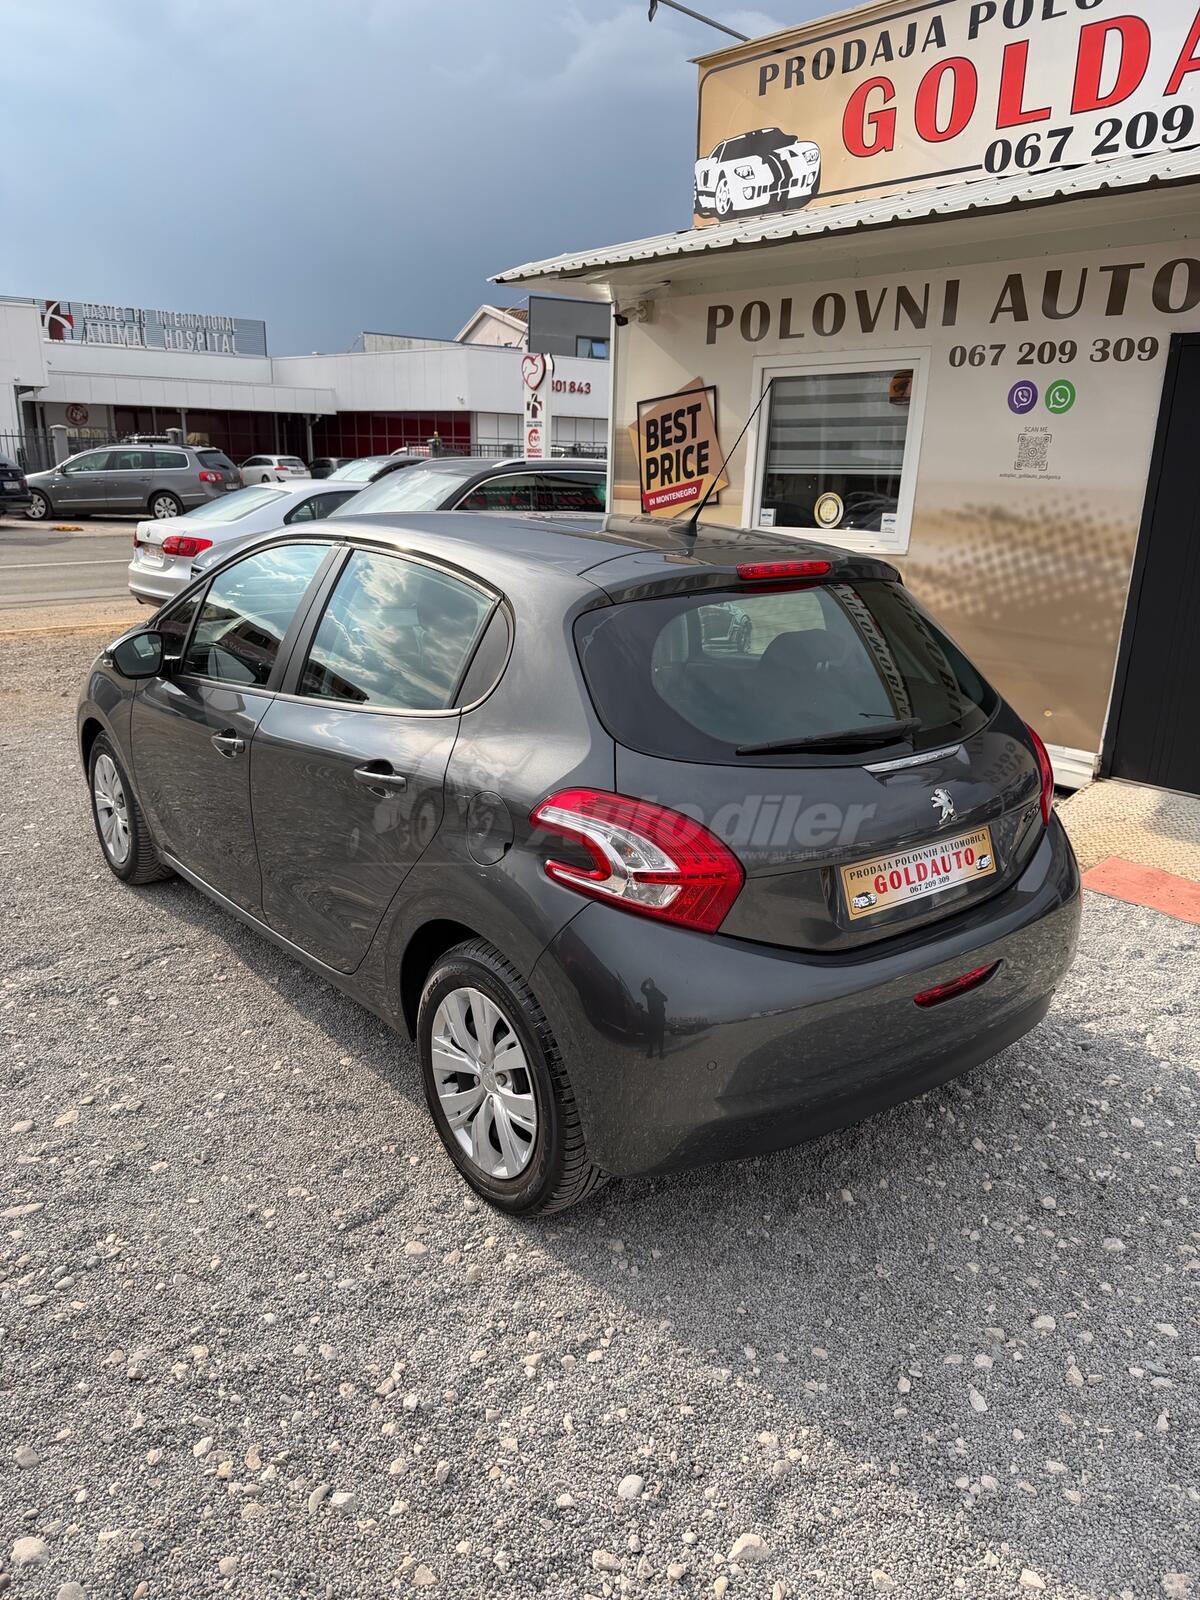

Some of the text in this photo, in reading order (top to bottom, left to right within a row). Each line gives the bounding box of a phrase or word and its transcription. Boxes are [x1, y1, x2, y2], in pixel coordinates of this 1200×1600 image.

[758, 0, 1104, 97] PRODAJA POL
[984, 104, 1194, 174] 067 209
[156, 310, 238, 332] INTERNATIONAL
[705, 257, 1200, 345] POLOVNI AUTO
[86, 322, 239, 354] ANIMAL HOSPITAL
[948, 336, 1160, 368] 067 209 309
[569, 381, 592, 394] 843
[645, 402, 702, 453] BEST
[645, 440, 709, 491] PRICE
[649, 487, 698, 506] IN MONTENEGRO
[849, 833, 987, 881] PRODAJA POLOVNIH AUTOMOBILA
[874, 847, 976, 895] GOLDAUTO
[909, 875, 950, 894] 067 209 309
